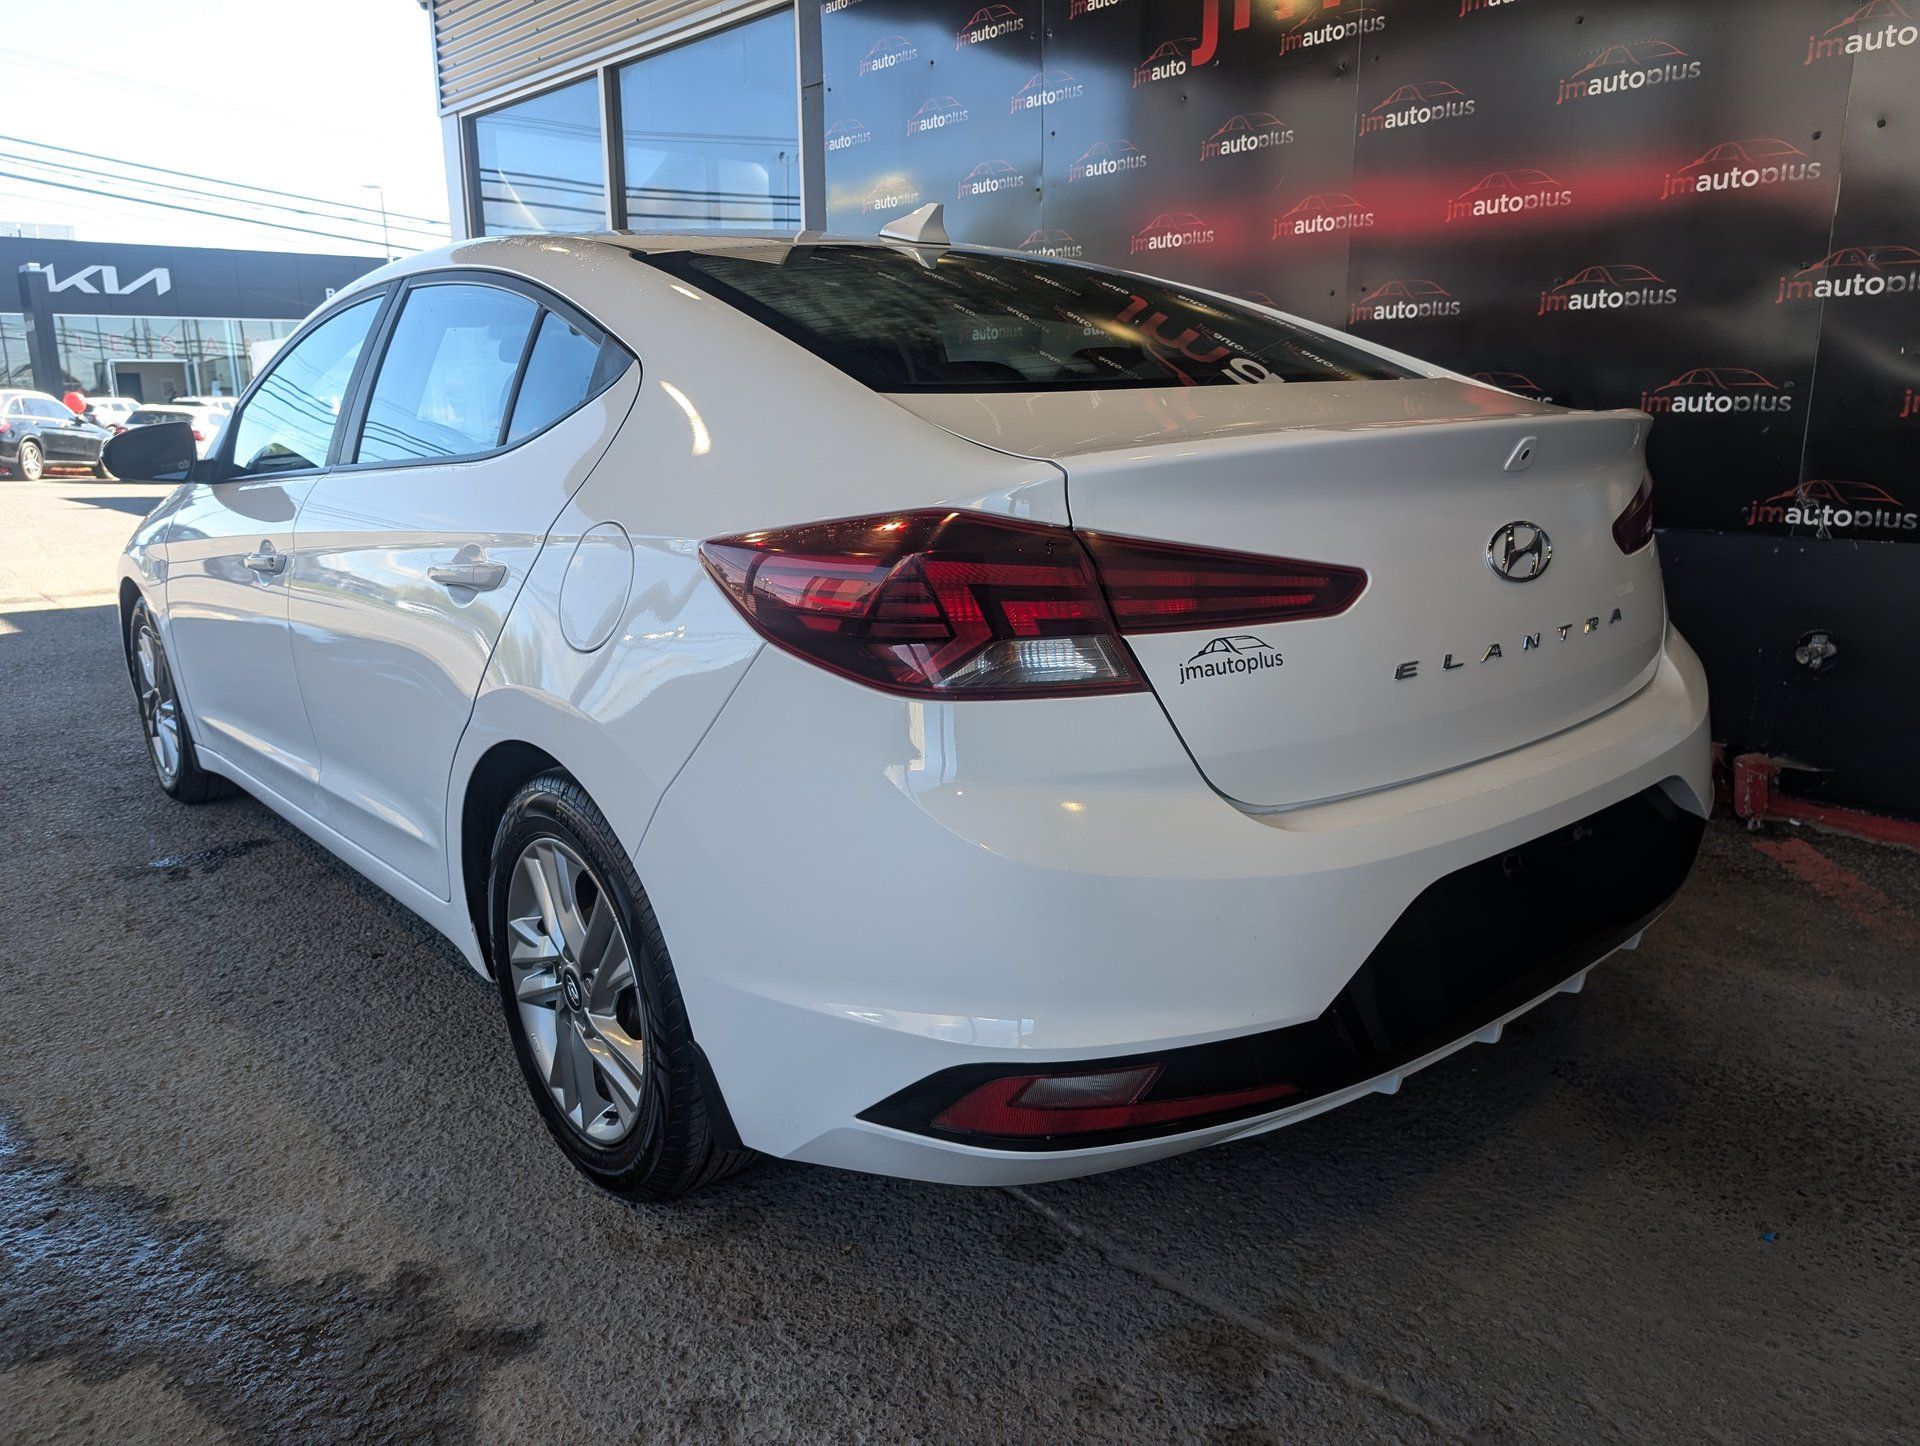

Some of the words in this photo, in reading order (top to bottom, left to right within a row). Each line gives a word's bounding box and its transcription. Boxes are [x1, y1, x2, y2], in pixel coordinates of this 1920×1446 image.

[955, 17, 1024, 50] jmautoplus
[1279, 16, 1386, 56] jmautoplus
[859, 43, 918, 77] jmautoplus
[1133, 60, 1187, 88] jmauto
[1010, 82, 1083, 114] jmautoplus
[1556, 60, 1702, 104] jmautoplus
[907, 109, 968, 136] jmautoplus
[1359, 100, 1476, 136] jmautoplus
[1200, 129, 1294, 161] jmautoplus
[1069, 153, 1147, 183] jmautoplus
[1661, 160, 1821, 199] jmautoplus
[957, 174, 1024, 199] jmautoplus
[1446, 188, 1572, 222] jmautoplus
[1272, 211, 1374, 239] jmautoplus
[1130, 229, 1214, 254] jmautoplus
[1348, 297, 1460, 325] jmautoplus
[1538, 286, 1677, 315] jmautoplus
[1640, 391, 1792, 413] jmautoplus
[1748, 500, 1918, 529] jmautoplus
[1393, 607, 1623, 682] ELANTRA
[1178, 651, 1284, 684] jmautoplus
